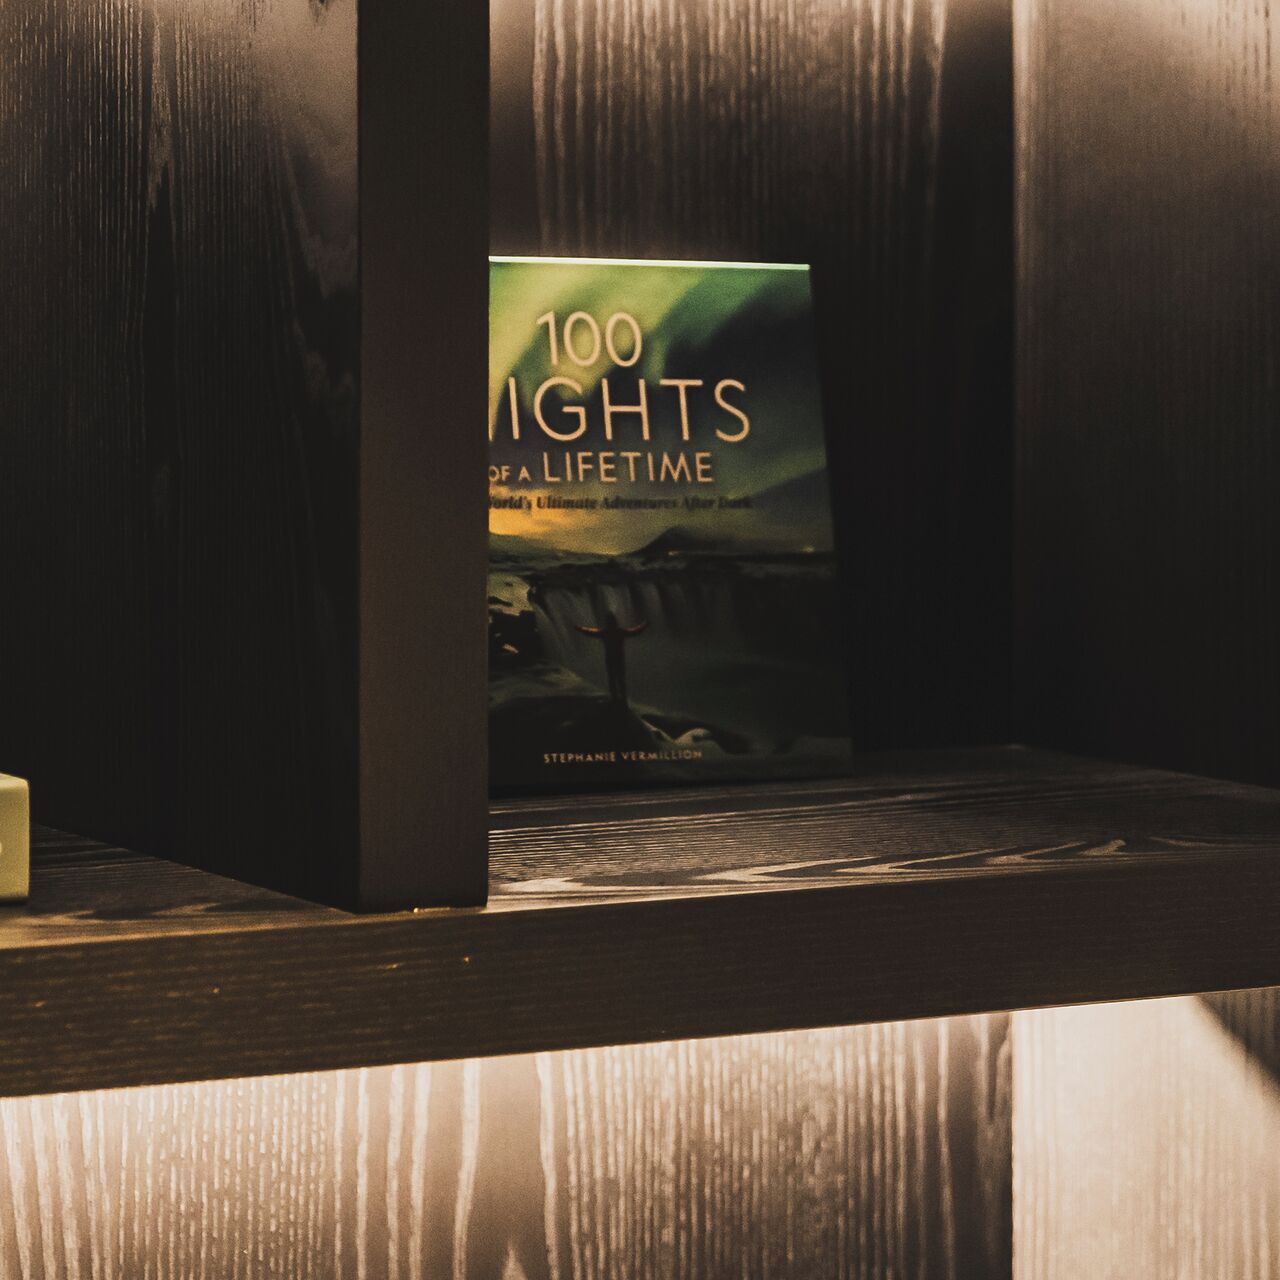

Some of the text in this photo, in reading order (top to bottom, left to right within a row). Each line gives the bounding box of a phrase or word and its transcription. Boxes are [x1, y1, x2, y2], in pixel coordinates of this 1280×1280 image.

[536, 310, 643, 369] 100
[488, 375, 751, 443] IGHTS
[488, 451, 715, 483] OF A LIFETIME
[488, 495, 532, 510] orld's
[536, 495, 598, 510] Ultimate
[602, 496, 678, 510] Adventures
[543, 749, 703, 764] STEPHANIE VERMILLION
